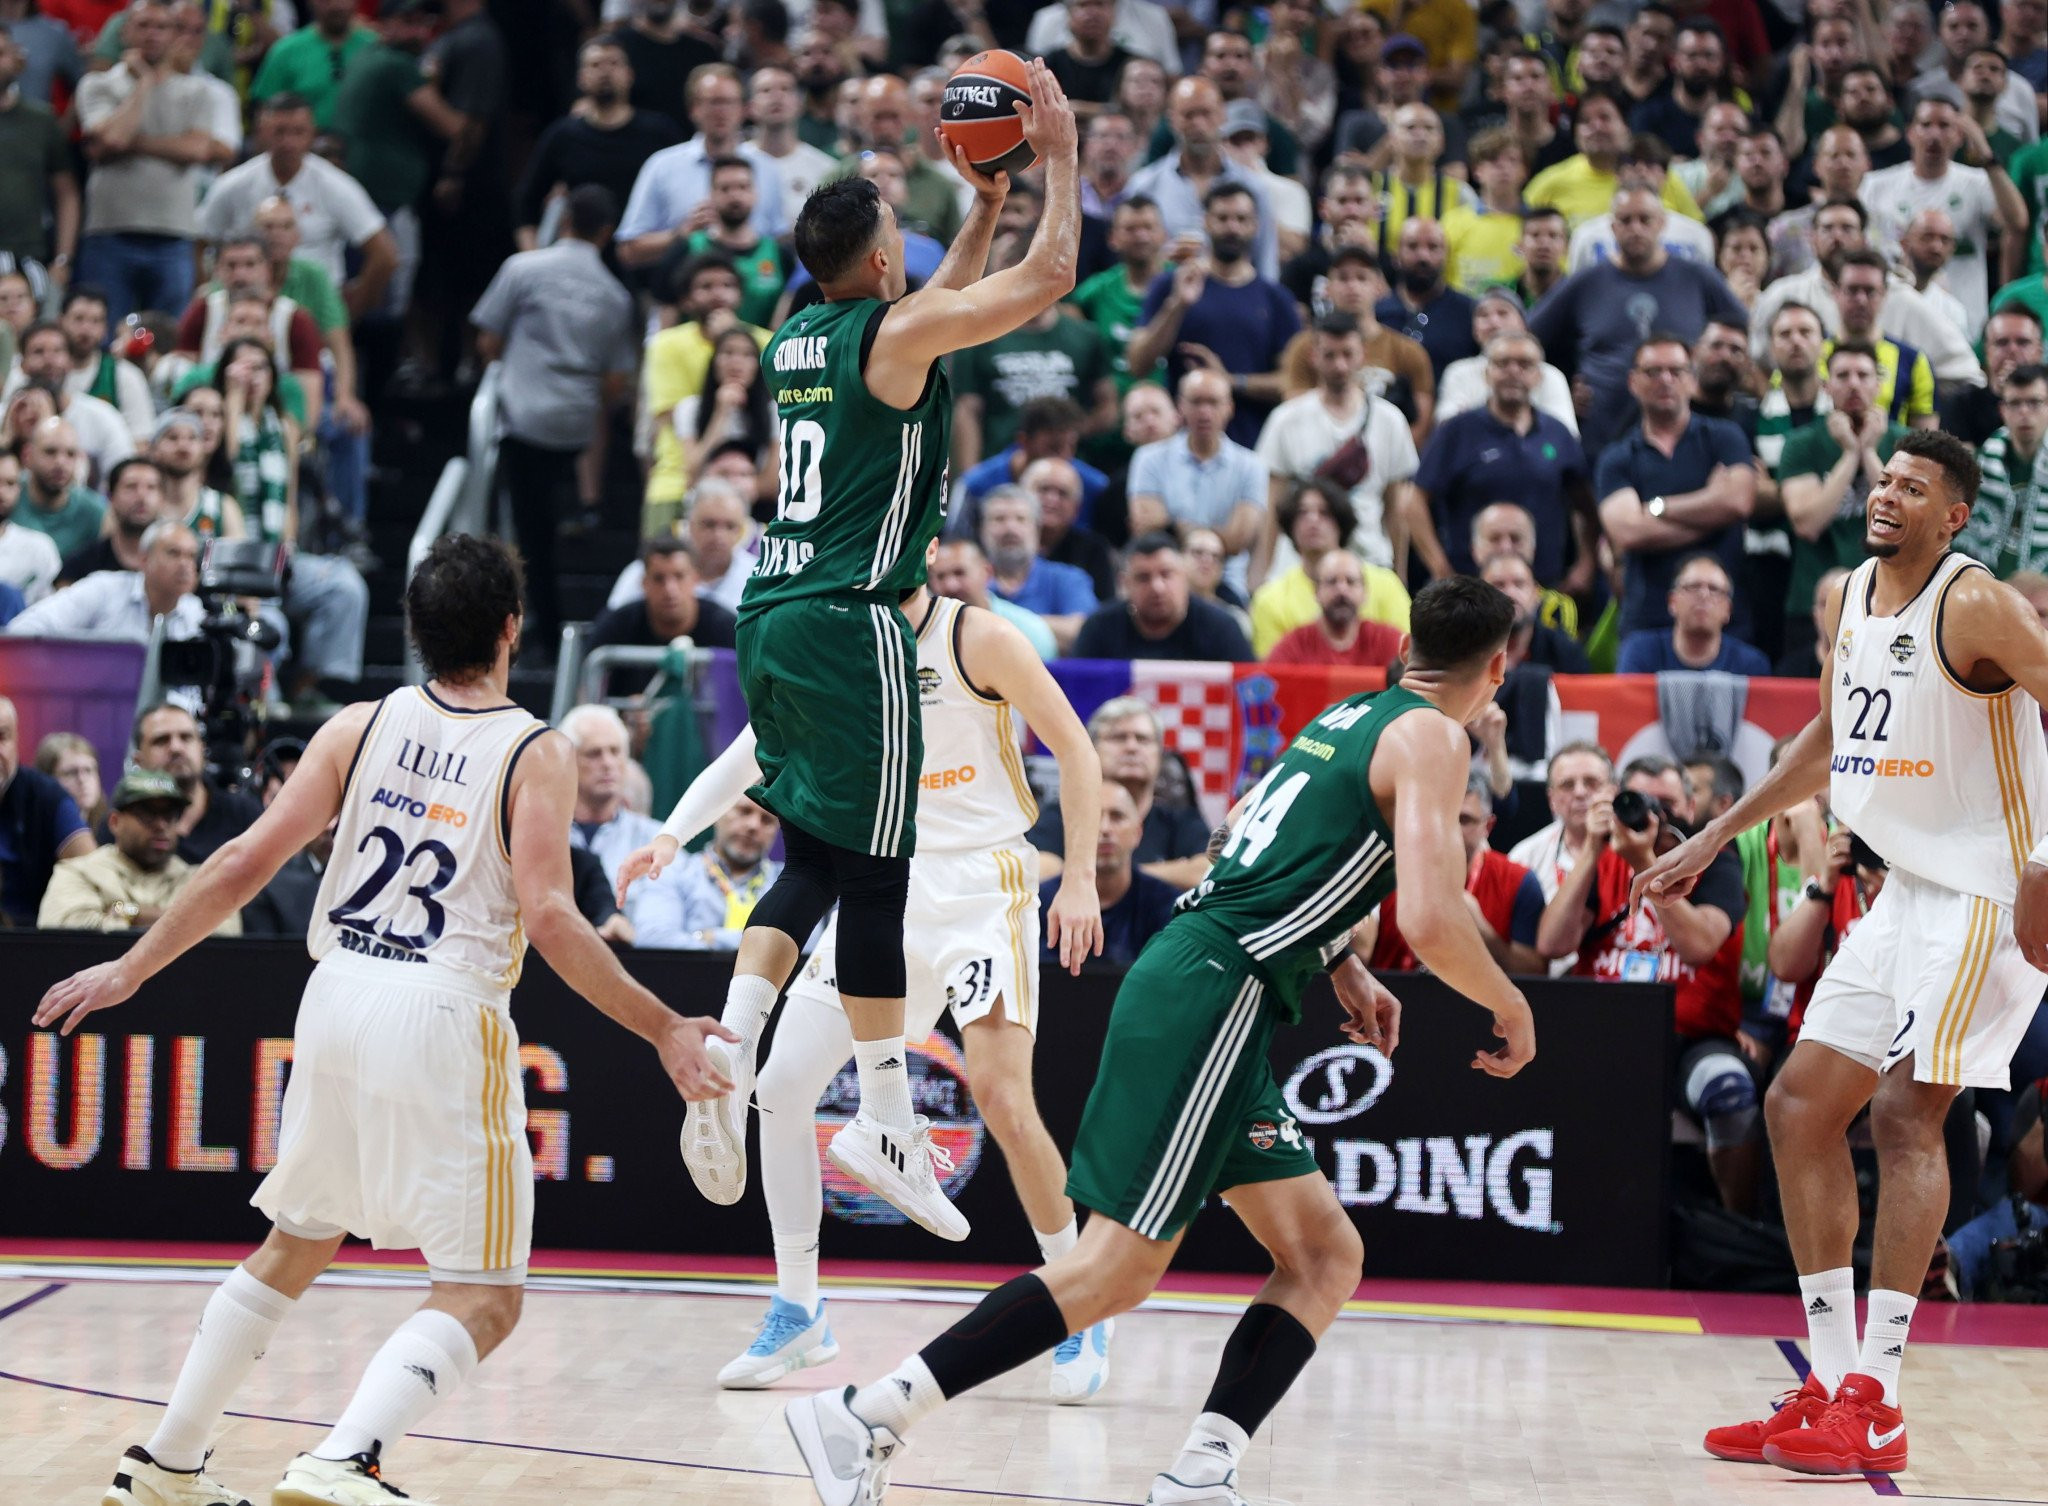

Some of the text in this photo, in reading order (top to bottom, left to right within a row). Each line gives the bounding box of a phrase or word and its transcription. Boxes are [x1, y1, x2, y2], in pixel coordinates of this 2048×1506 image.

[777, 418, 826, 522] 10
[1848, 686, 1892, 742] 22
[1831, 754, 1935, 778] AUTOHERO
[370, 787, 468, 828] AUTOERO
[328, 825, 457, 950] 23
[959, 957, 993, 1009] 31
